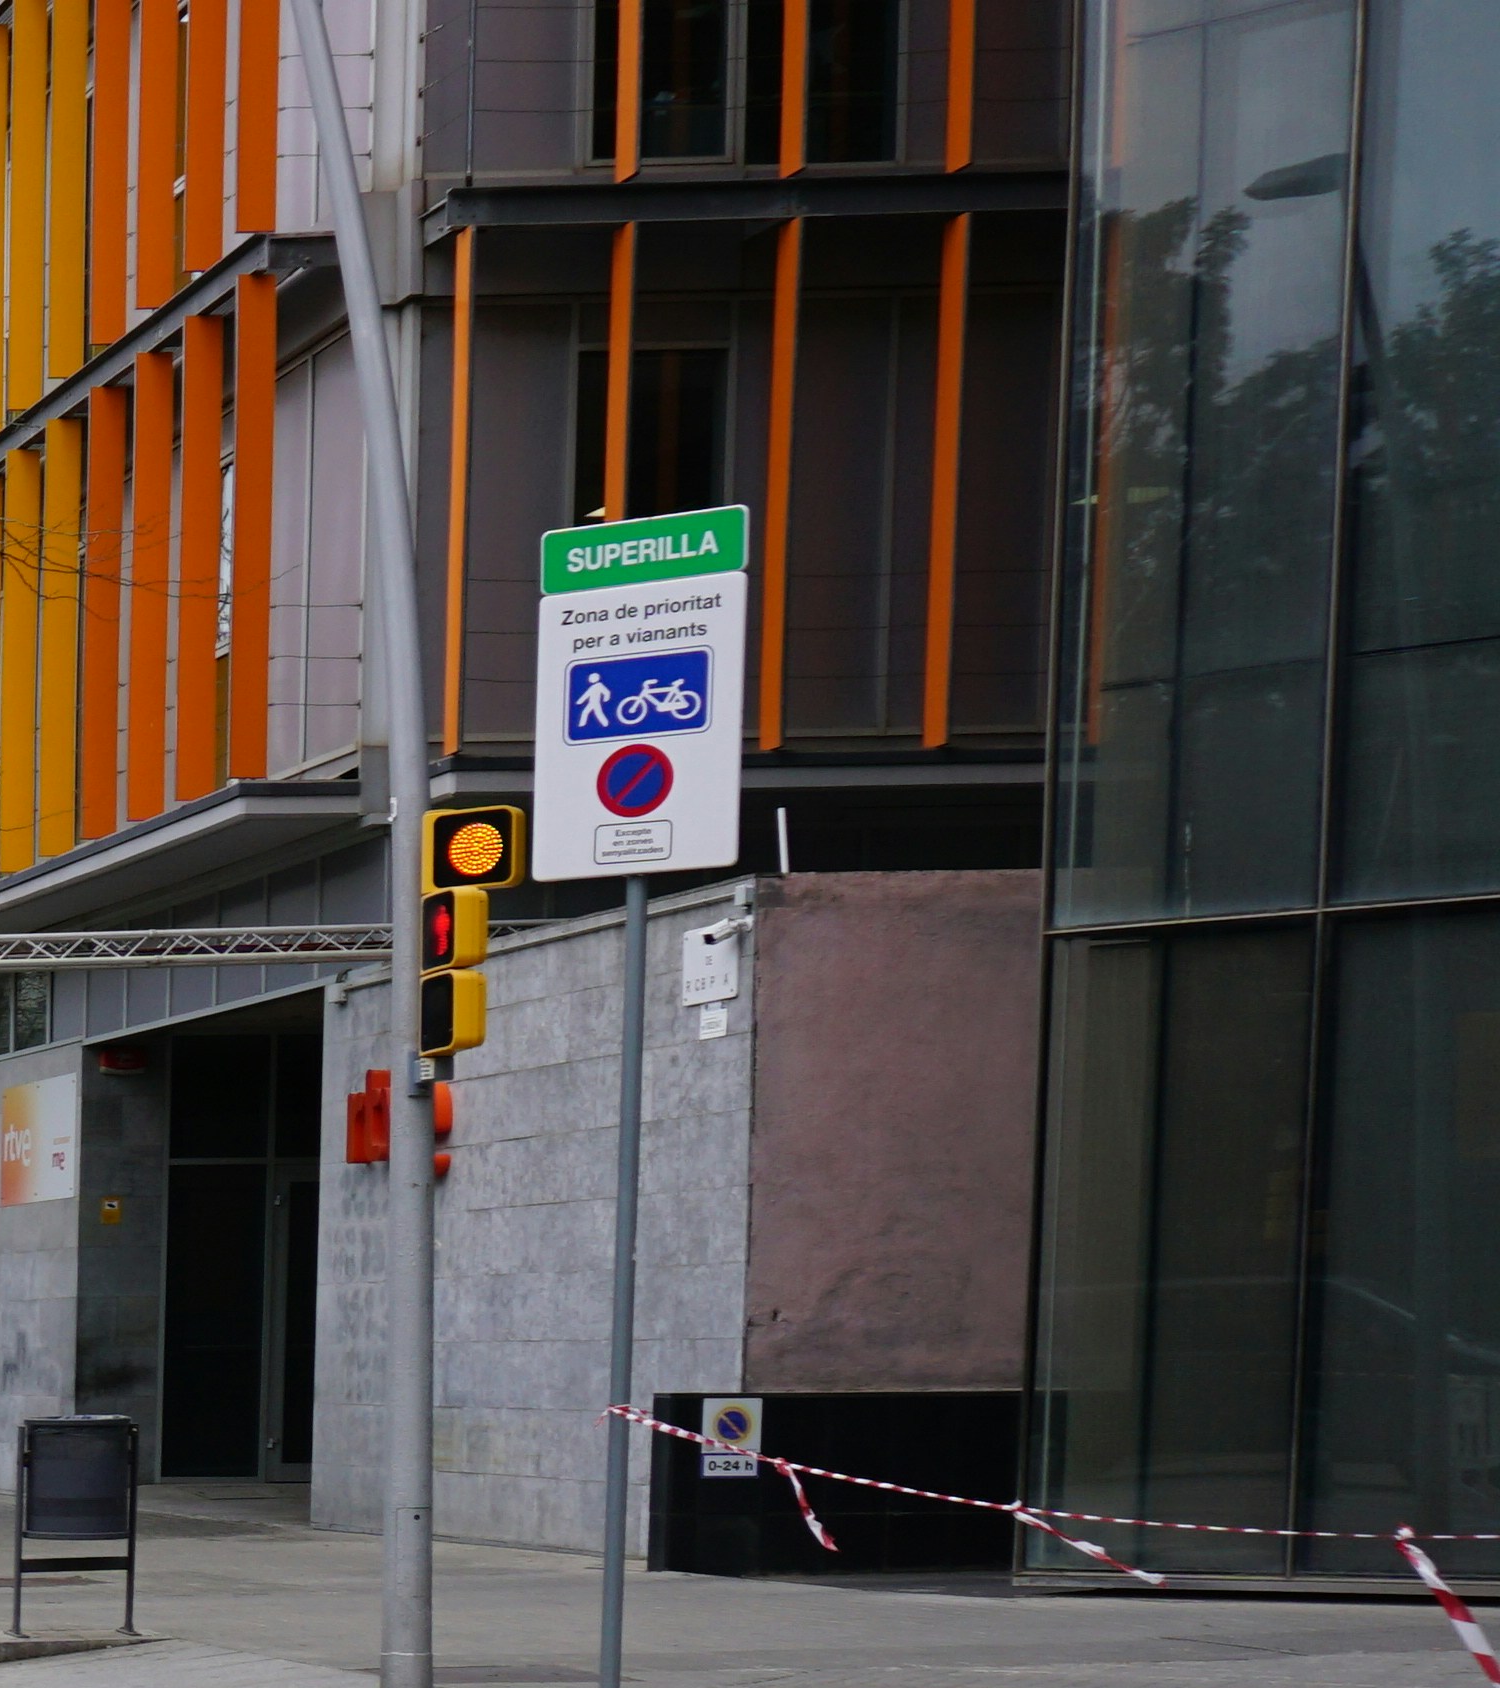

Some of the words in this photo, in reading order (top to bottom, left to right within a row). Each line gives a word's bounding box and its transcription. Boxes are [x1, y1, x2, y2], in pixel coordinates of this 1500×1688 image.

[566, 529, 719, 574] SUPERILLA
[561, 608, 609, 627] Zona
[614, 602, 639, 621] de
[643, 592, 724, 620] prioritat
[572, 633, 604, 653] per
[609, 630, 621, 647] a
[626, 621, 708, 645] vianants
[3, 1124, 32, 1167] rtve
[708, 1460, 741, 1472] 0-24
[745, 1460, 754, 1471] h
